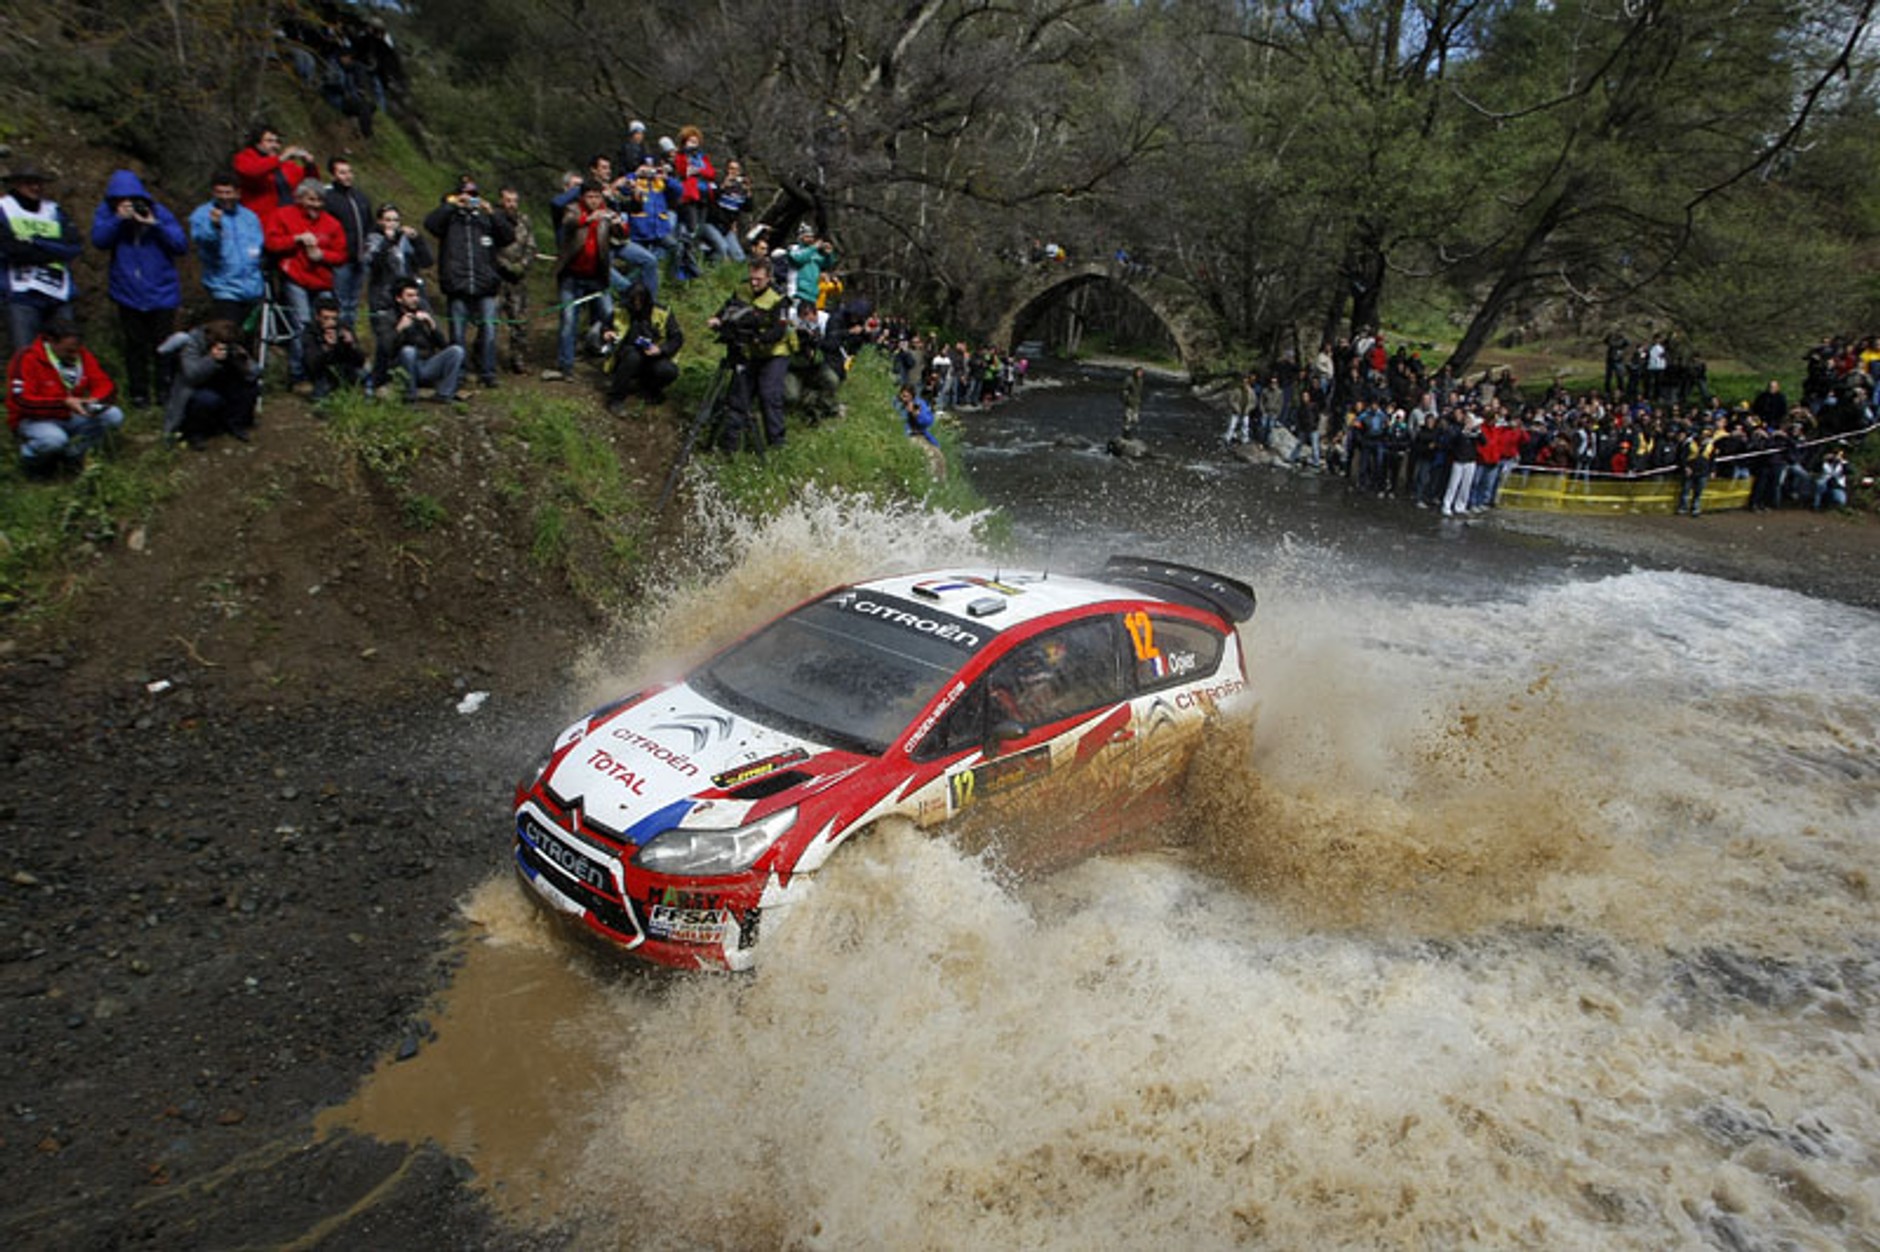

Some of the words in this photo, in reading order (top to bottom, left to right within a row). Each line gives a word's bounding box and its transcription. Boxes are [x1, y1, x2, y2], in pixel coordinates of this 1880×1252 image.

[1124, 611, 1160, 661] 12
[1168, 651, 1195, 675] Ogier
[587, 750, 646, 796] TOTAL
[612, 728, 699, 777] CITROËN
[953, 769, 976, 808] 12
[652, 906, 719, 925] FFSA
